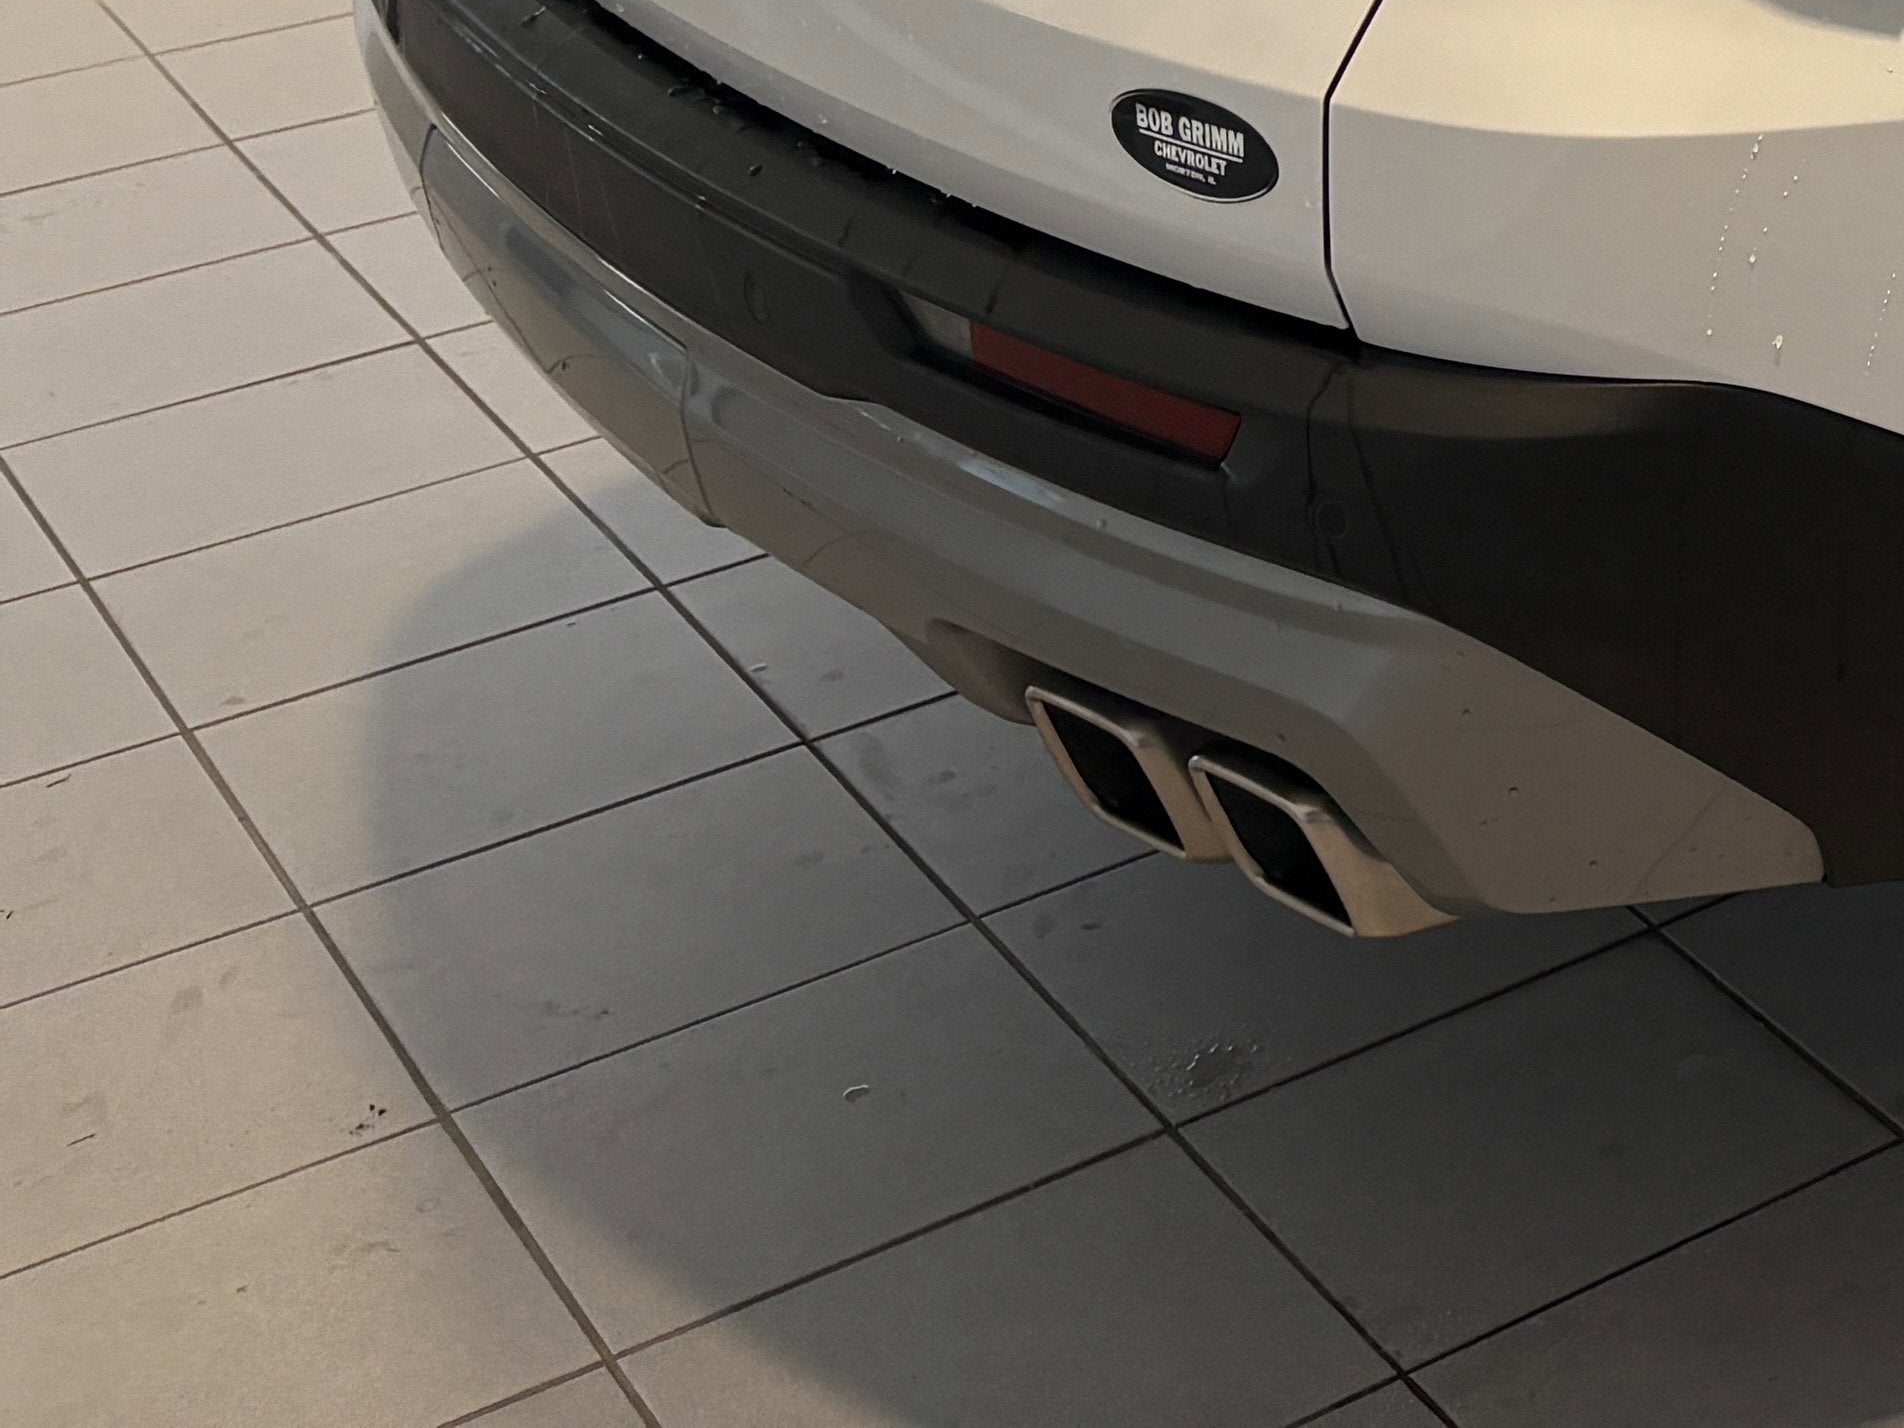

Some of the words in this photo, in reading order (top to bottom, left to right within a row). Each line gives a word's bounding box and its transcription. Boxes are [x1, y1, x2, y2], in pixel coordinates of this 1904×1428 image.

[1135, 102, 1174, 136] BOB
[1178, 116, 1245, 158] GRIMM
[1154, 140, 1227, 176] CHEVROLET
